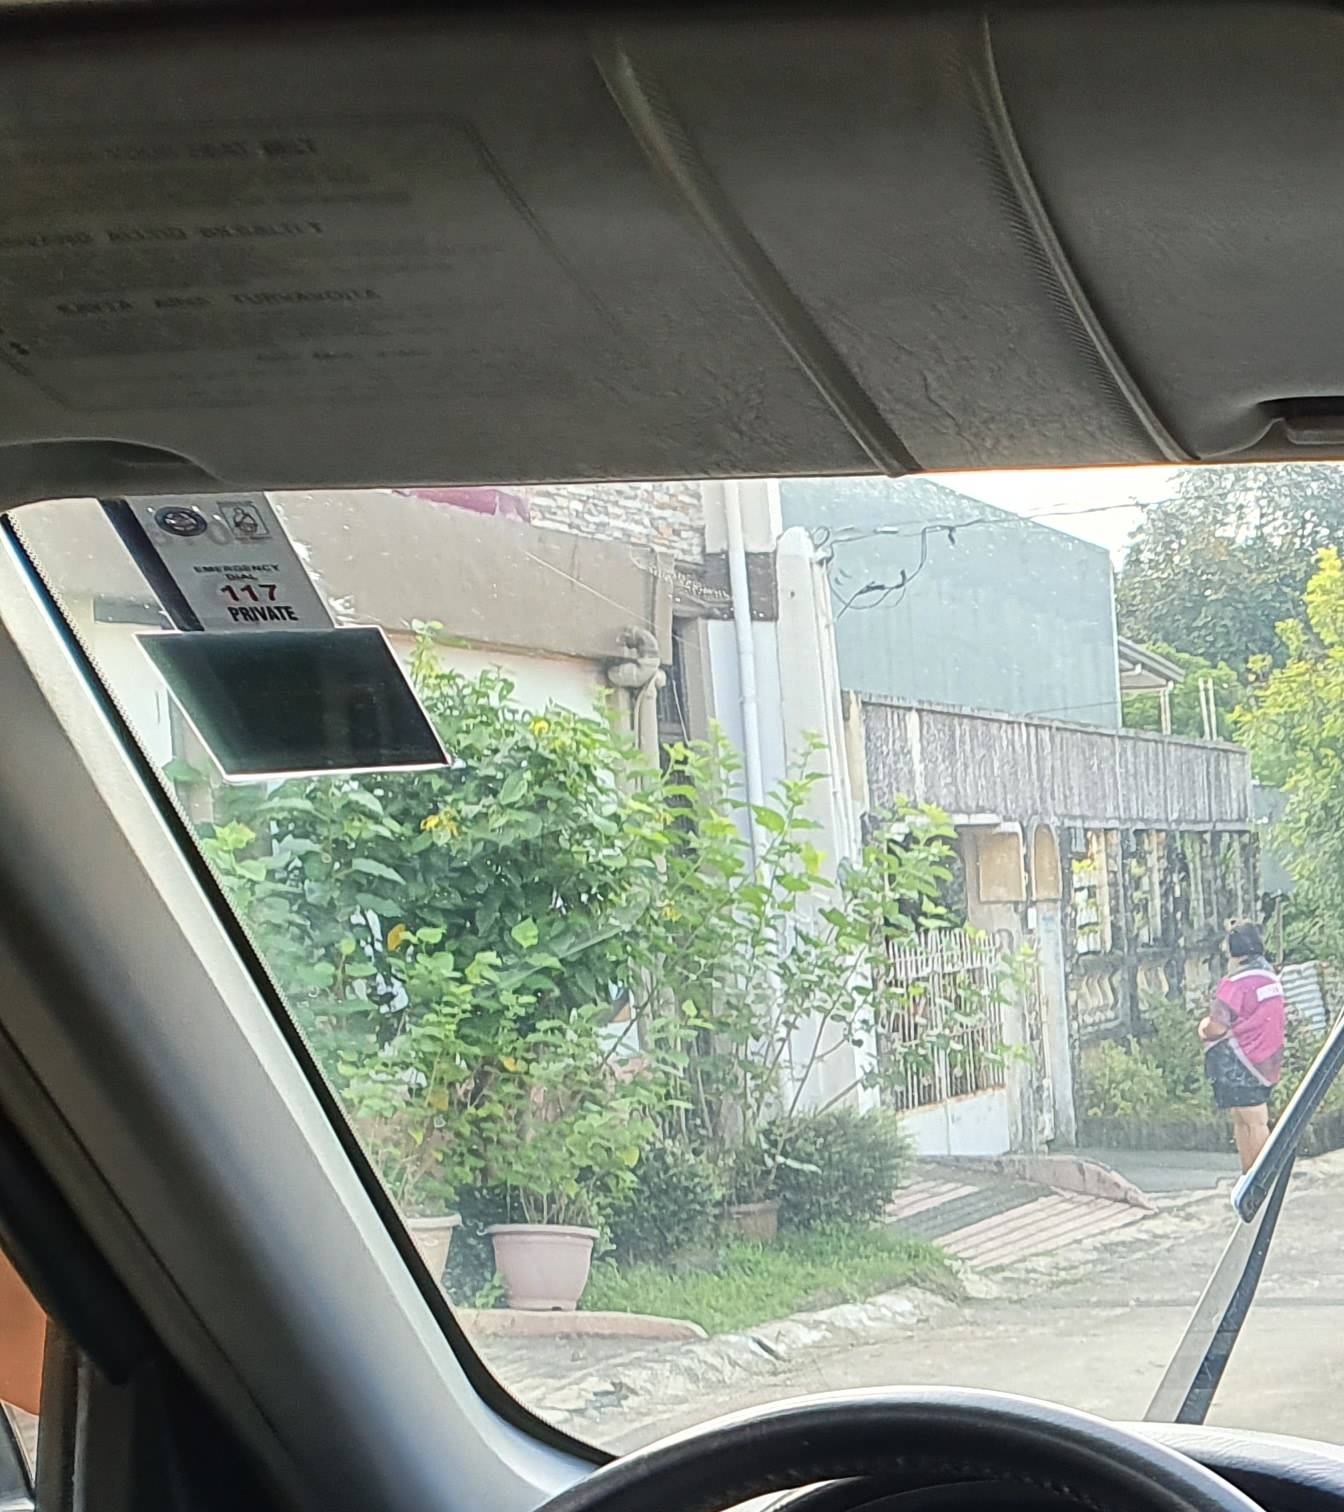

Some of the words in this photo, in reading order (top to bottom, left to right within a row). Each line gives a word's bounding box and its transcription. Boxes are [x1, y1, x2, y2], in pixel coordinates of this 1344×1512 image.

[193, 564, 281, 573] EMERGENCY
[226, 573, 259, 581] DIAL
[220, 583, 278, 602] 117
[227, 605, 299, 622] PRIVATE
